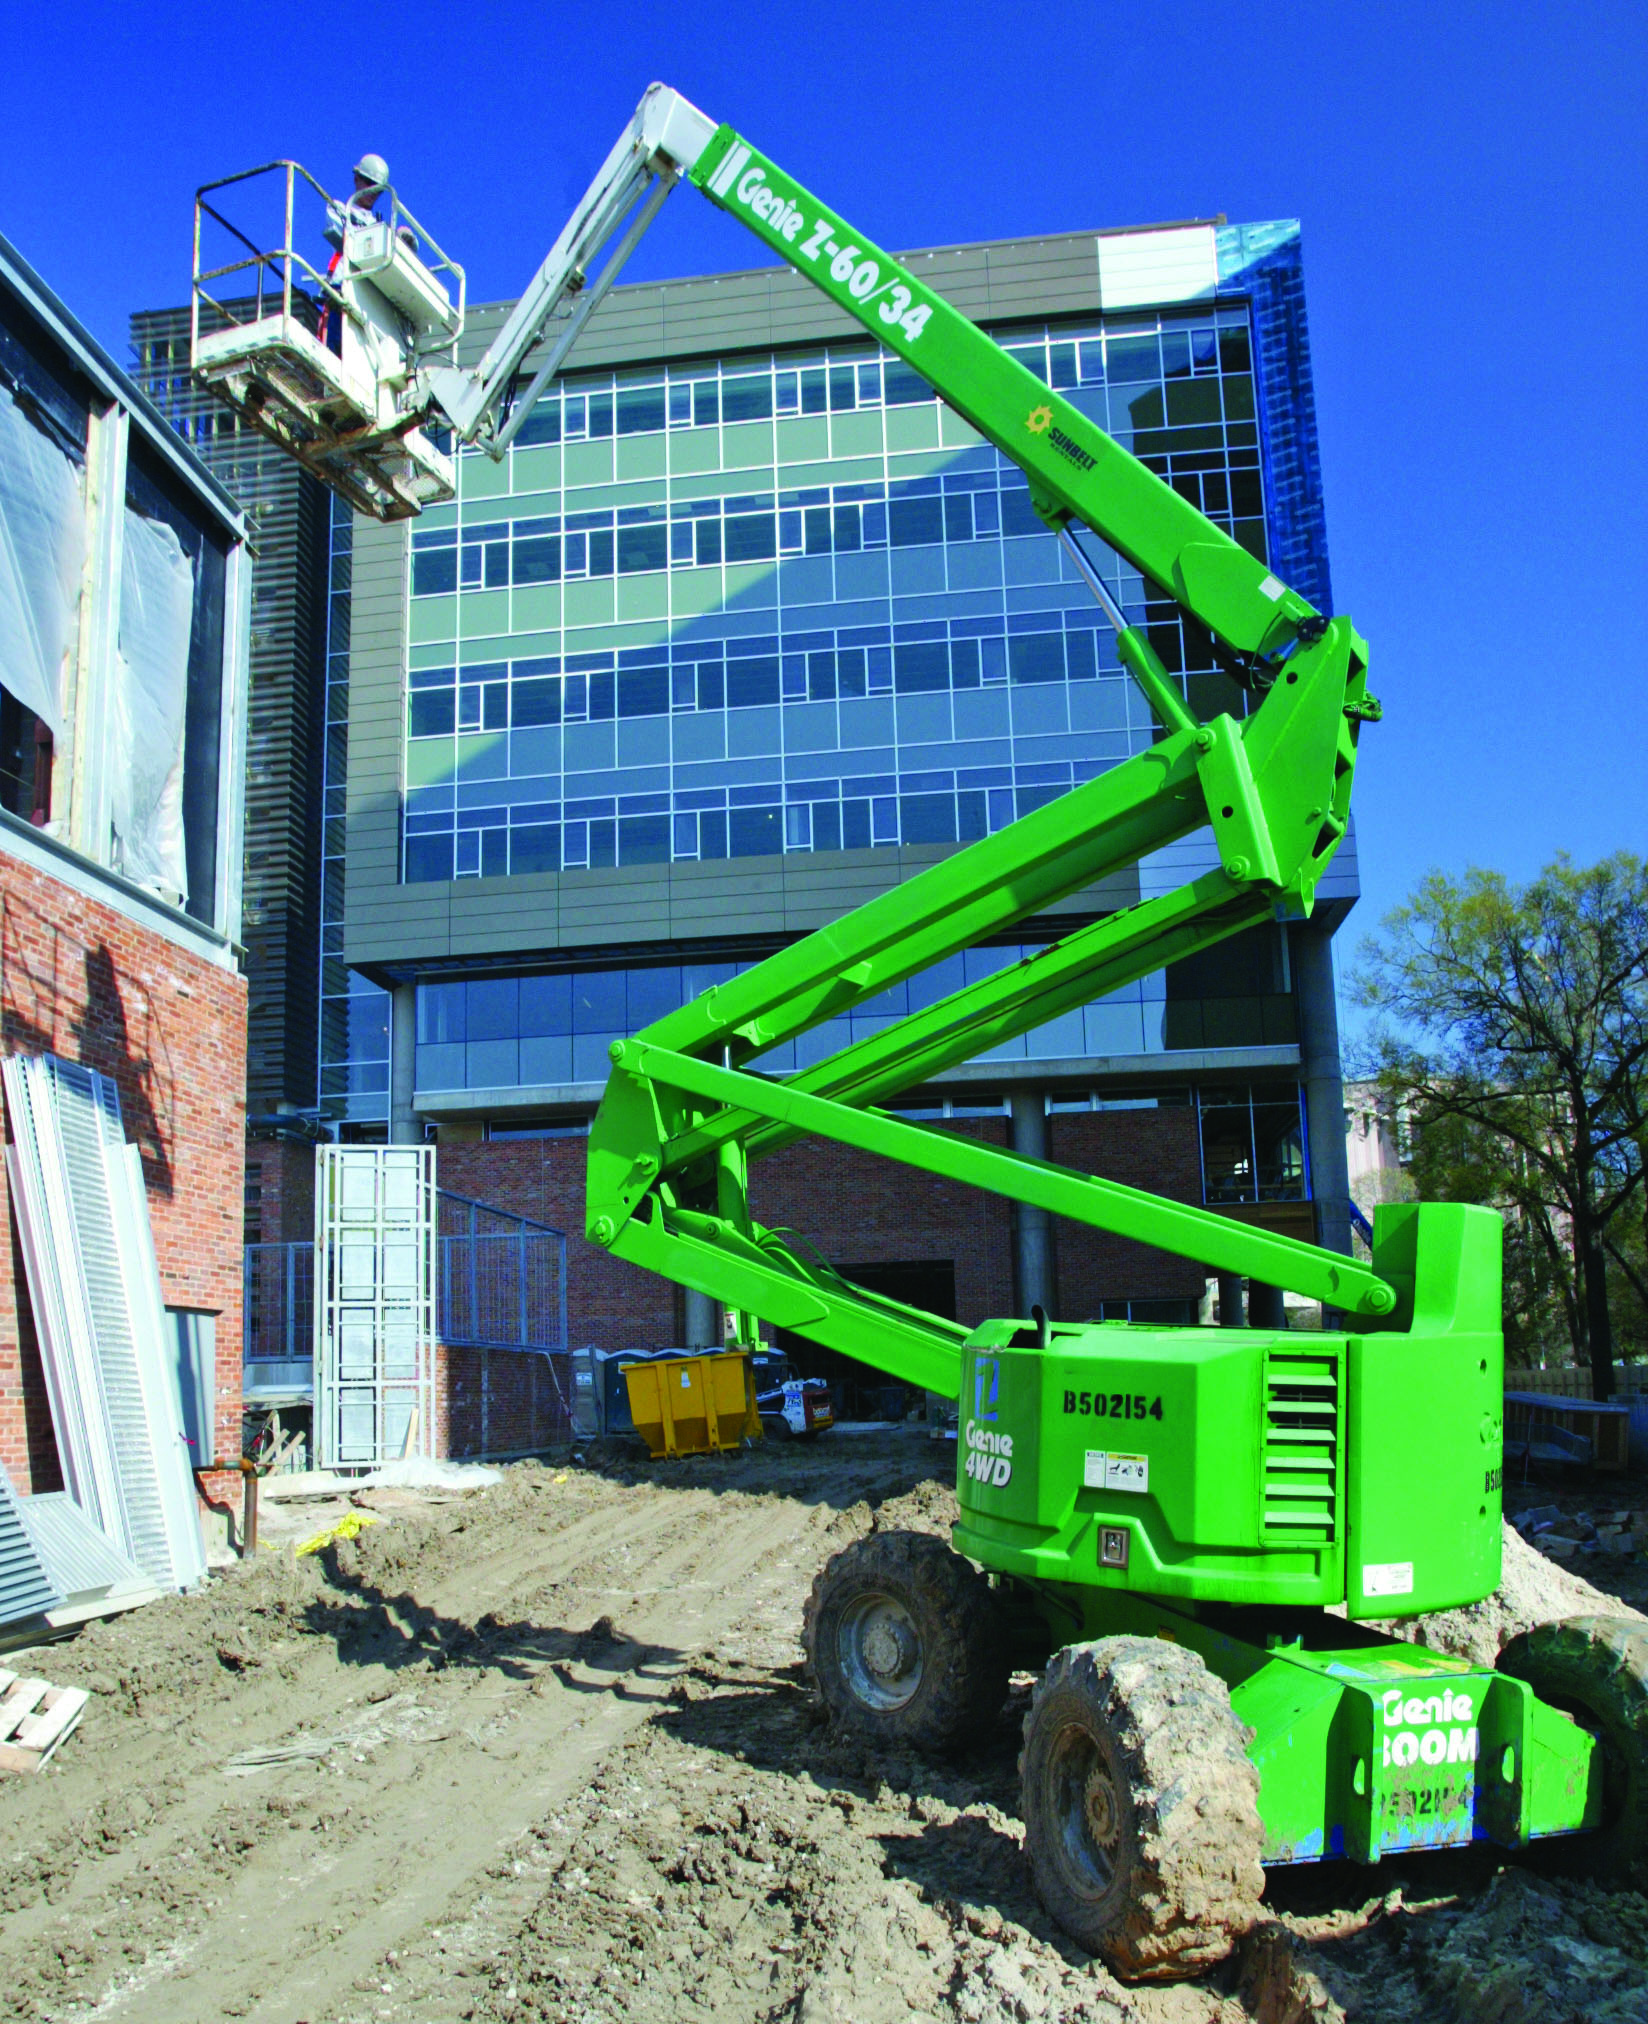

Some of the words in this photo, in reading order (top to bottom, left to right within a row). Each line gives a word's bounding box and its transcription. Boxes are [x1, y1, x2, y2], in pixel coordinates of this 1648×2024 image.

[736, 167, 804, 242] Genie
[799, 218, 933, 342] Z-60/34
[1048, 427, 1098, 471] SUNBELT
[1064, 1390, 1163, 1421] B502154
[966, 1419, 1013, 1457] Genie
[965, 1451, 1012, 1487] 4WD
[1382, 1688, 1473, 1726] Genie
